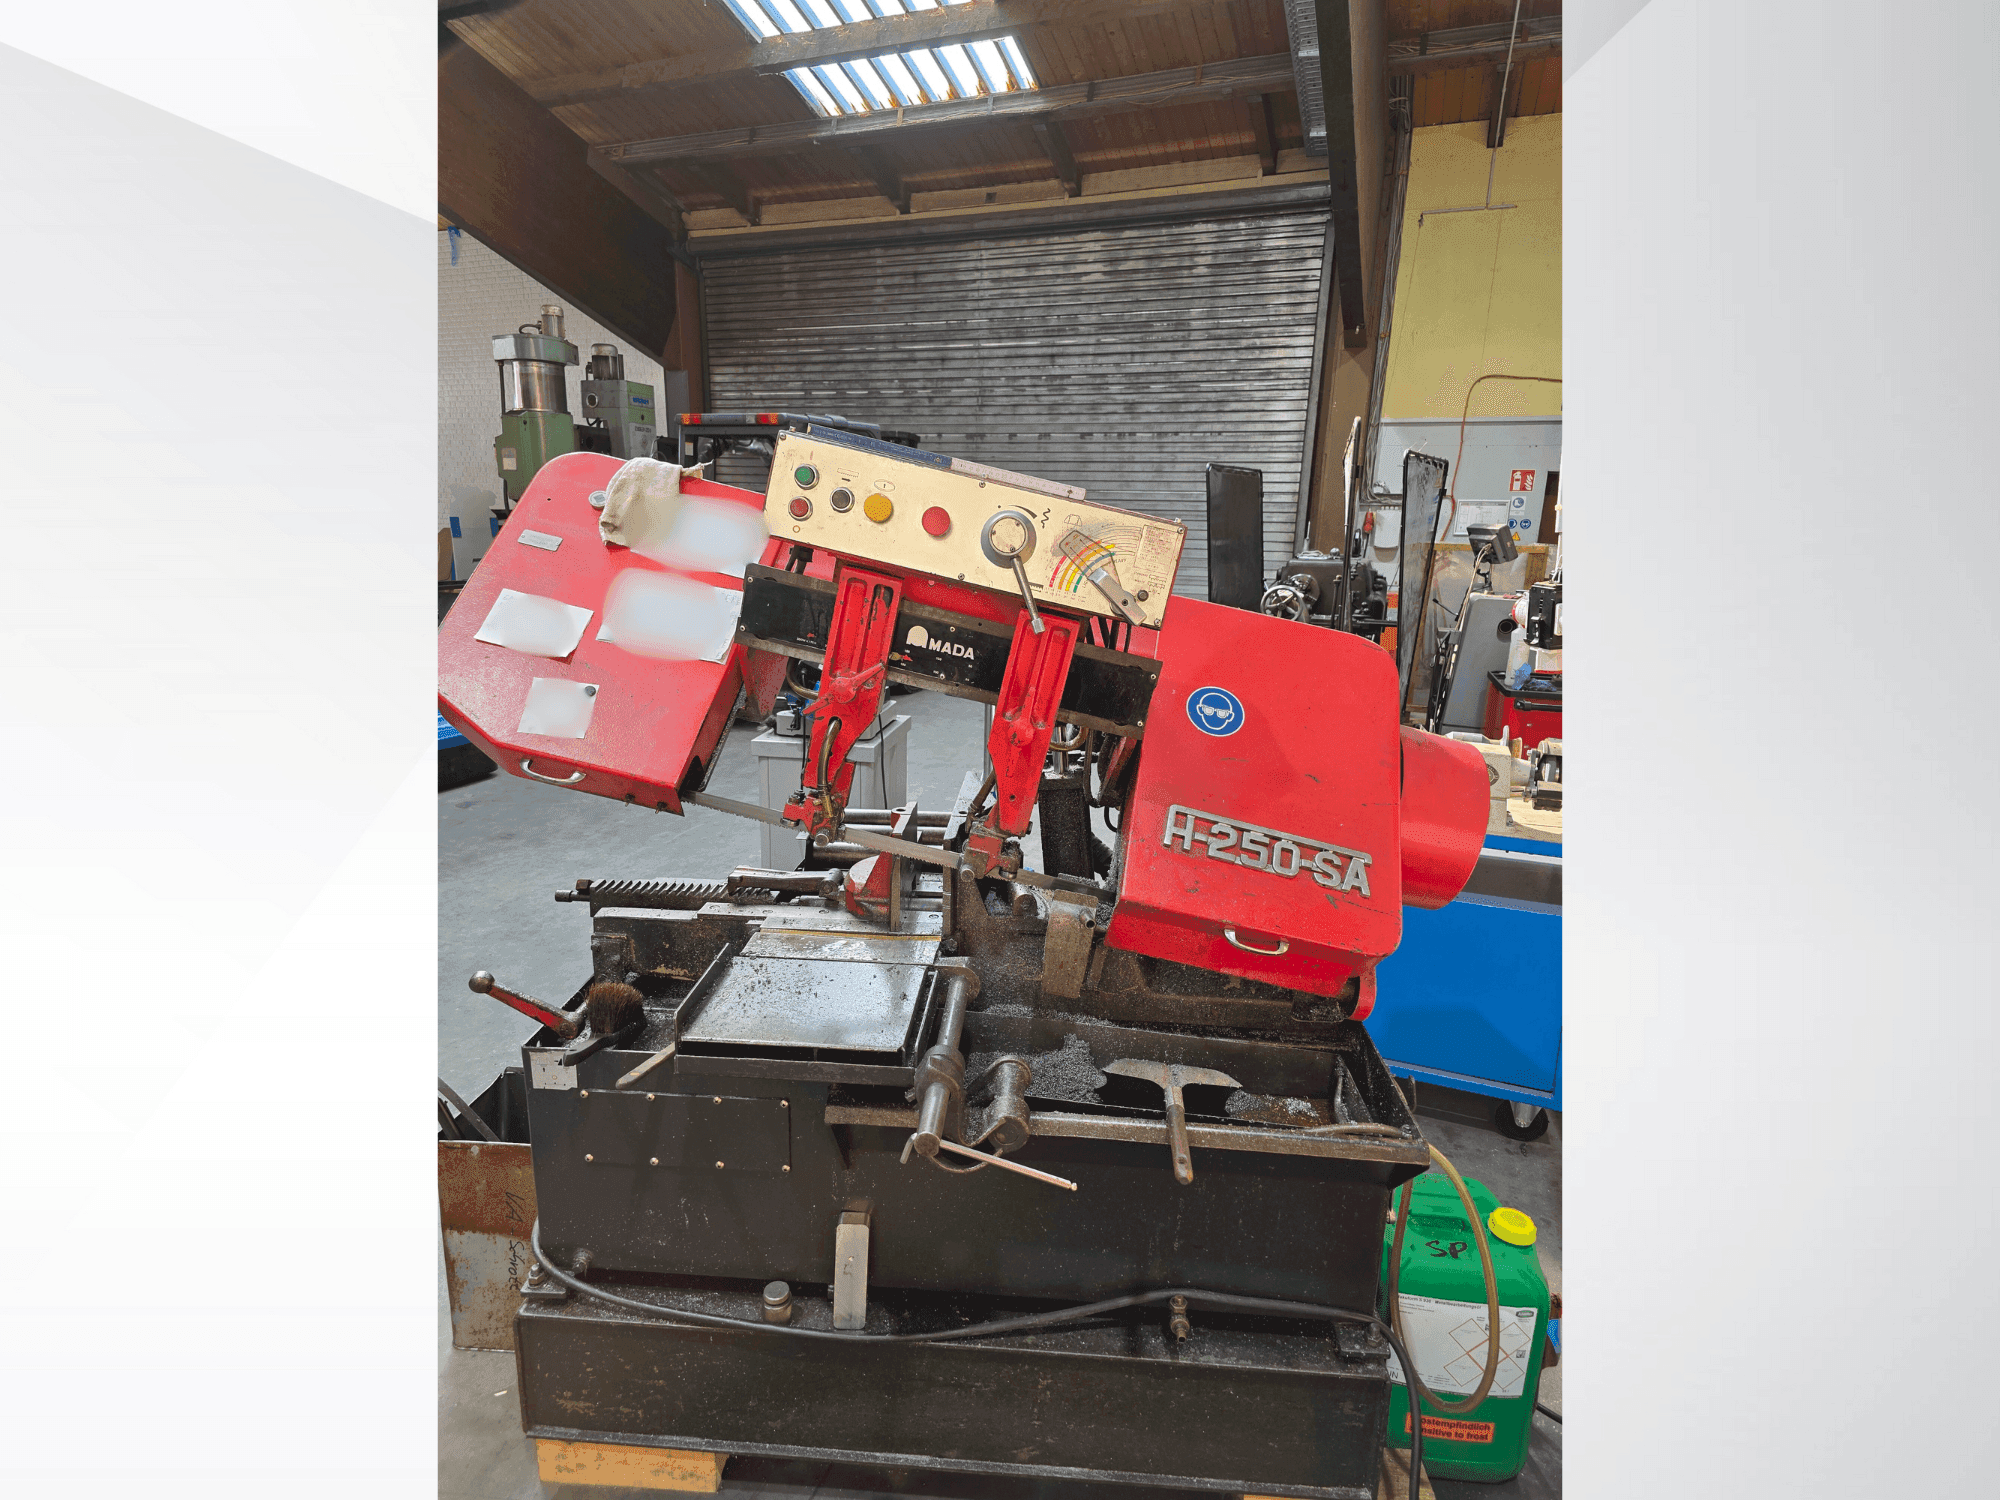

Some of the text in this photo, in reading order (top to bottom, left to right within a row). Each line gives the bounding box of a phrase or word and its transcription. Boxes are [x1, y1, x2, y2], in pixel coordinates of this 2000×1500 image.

[906, 625, 975, 660] AMADA
[1163, 804, 1373, 898] H-250-SA
[1425, 1240, 1468, 1259] SP
[1454, 1430, 1465, 1438] to
[1466, 1431, 1489, 1441] frost
